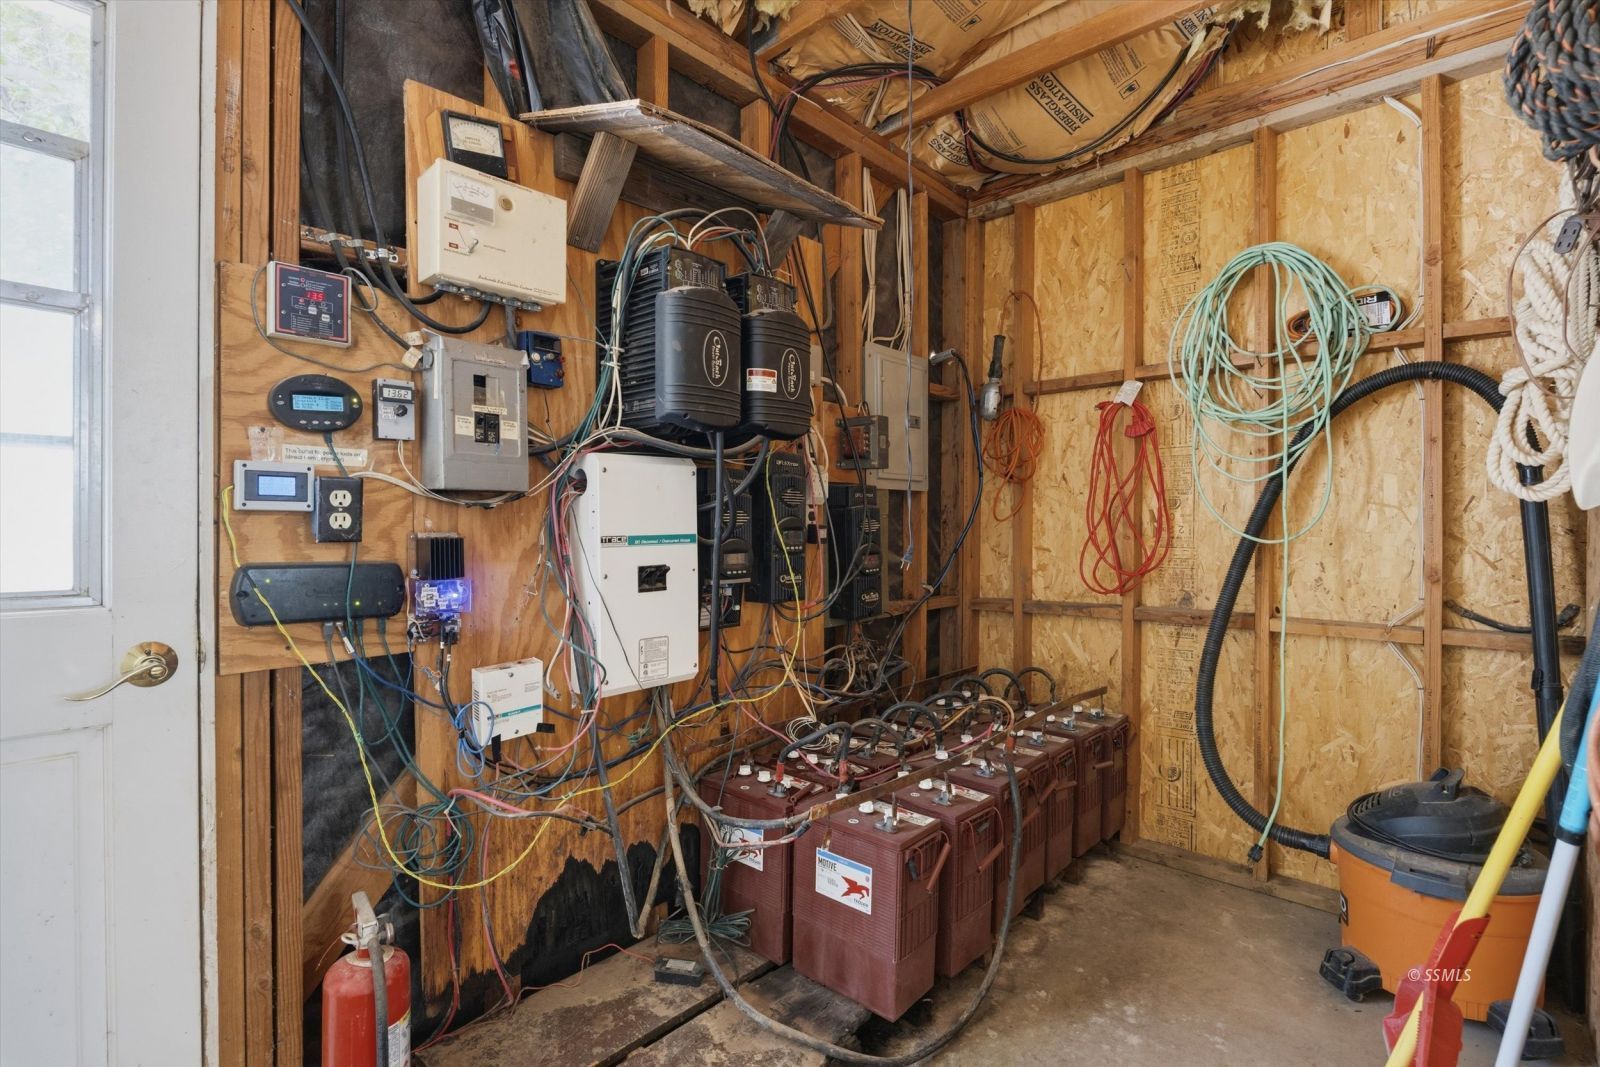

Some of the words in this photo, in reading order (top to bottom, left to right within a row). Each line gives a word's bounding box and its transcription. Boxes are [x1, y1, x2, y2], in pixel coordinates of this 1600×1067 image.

[1028, 80, 1081, 133] FIBERGLASS
[1038, 72, 1091, 125] INSULATION
[817, 857, 837, 872] MOTIVE
